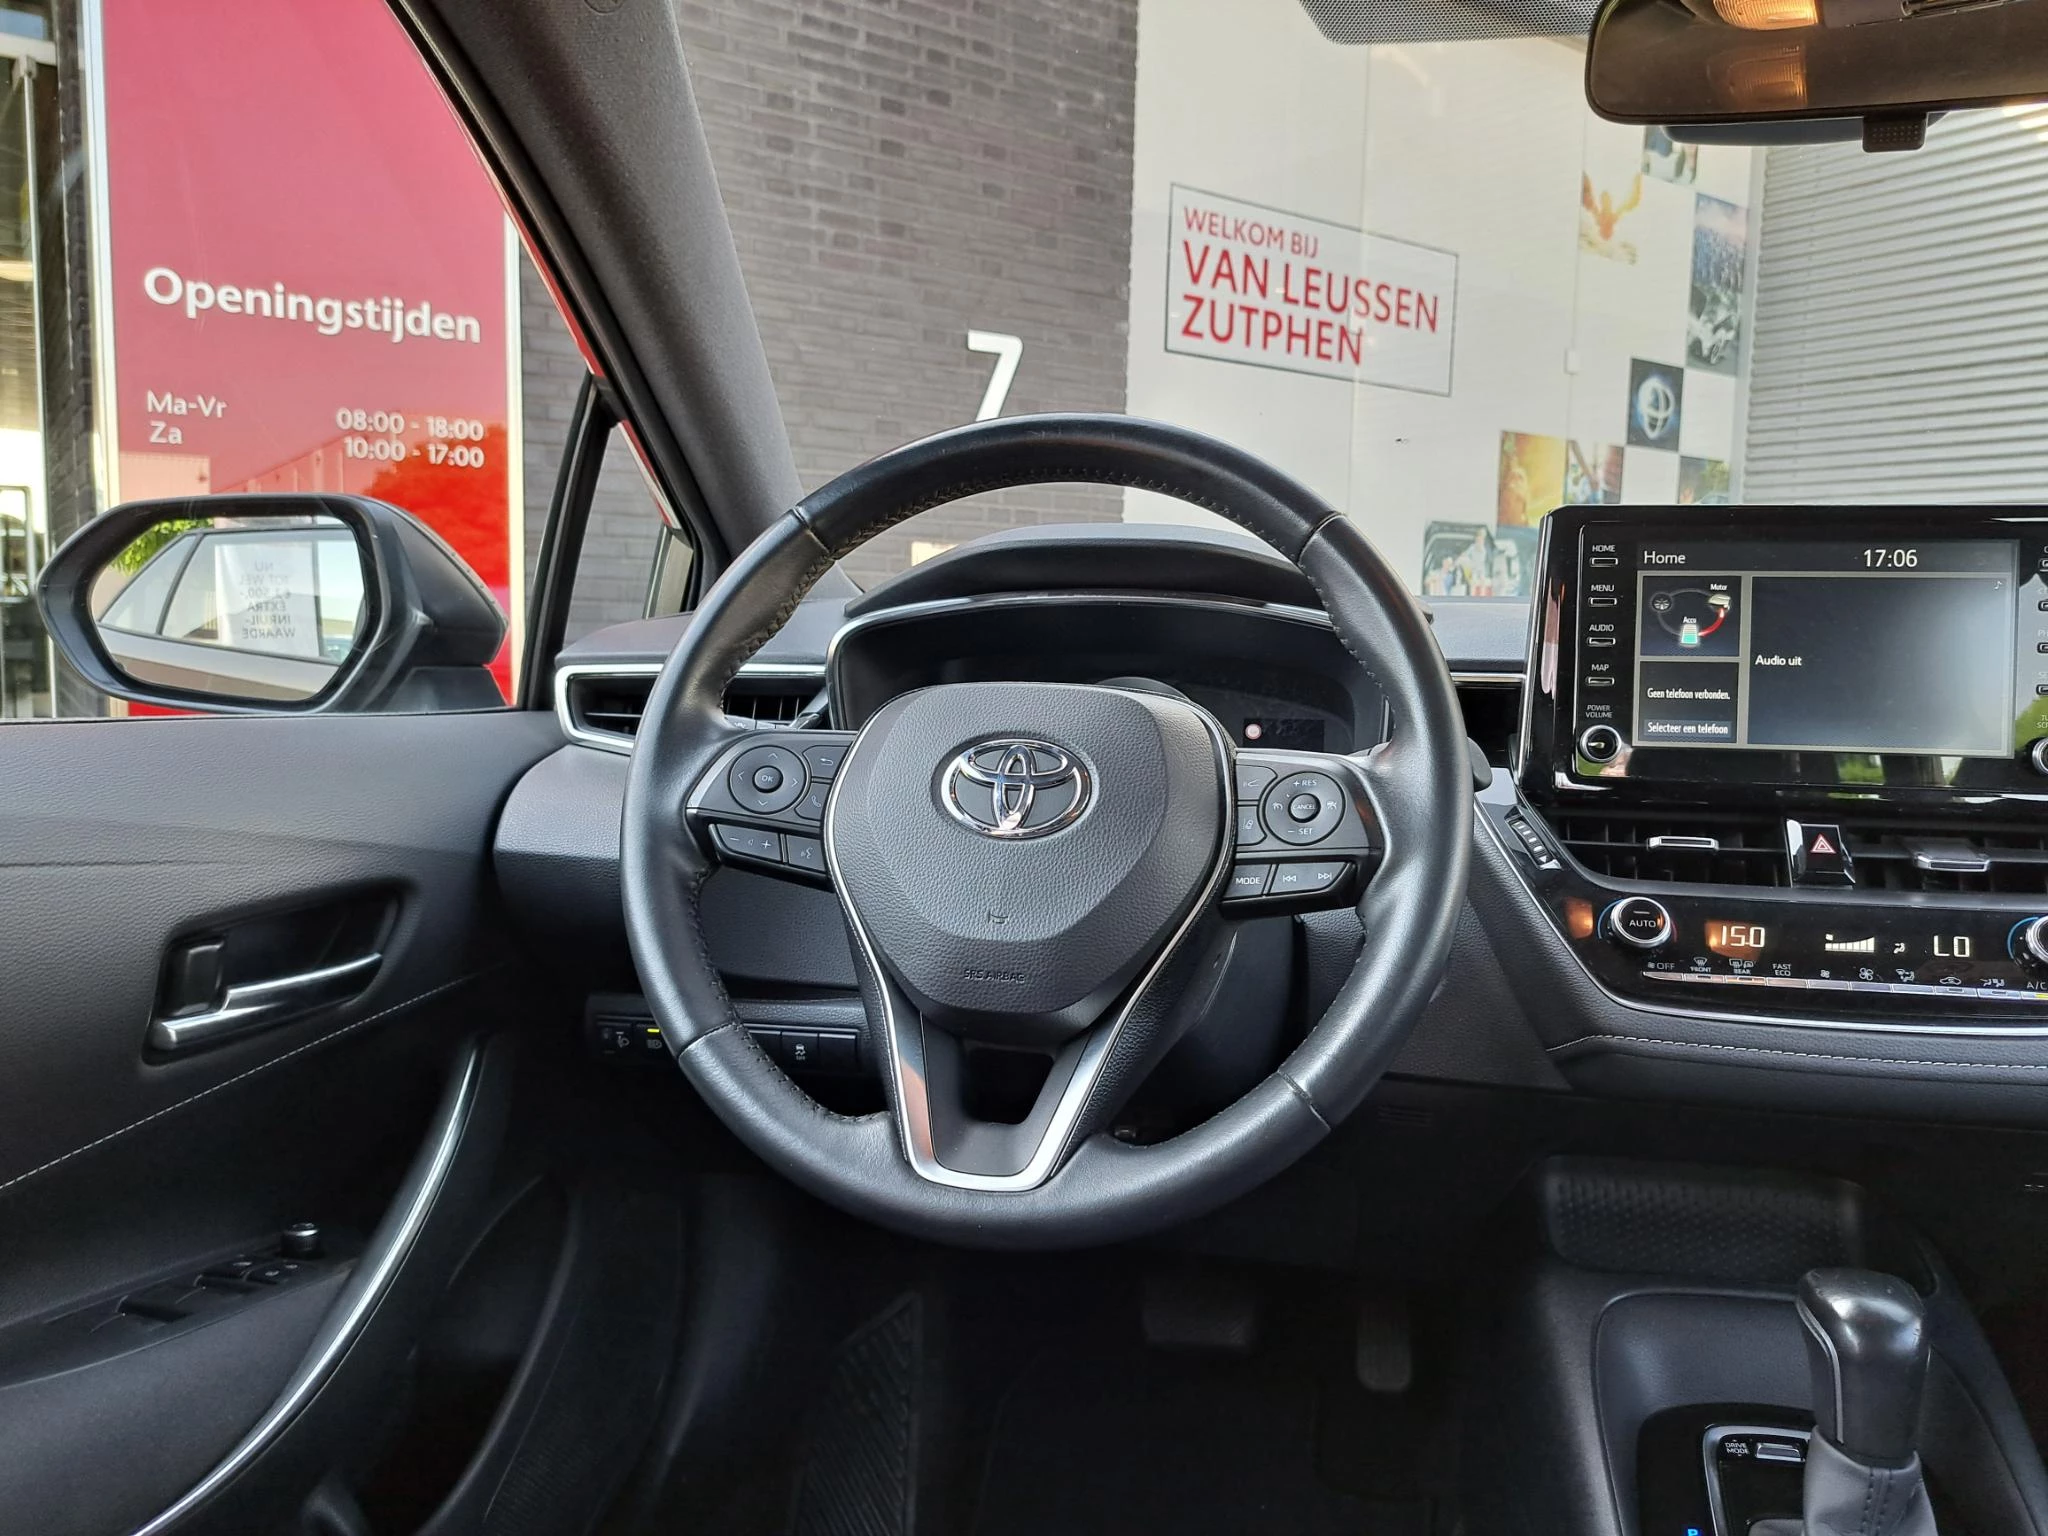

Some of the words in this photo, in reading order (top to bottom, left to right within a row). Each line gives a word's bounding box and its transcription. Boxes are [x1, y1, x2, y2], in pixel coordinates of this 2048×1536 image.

[1184, 206, 1284, 253] WELKOM
[1290, 232, 1319, 259] BIJ
[1183, 239, 1269, 300] VAN
[1283, 263, 1439, 333] LEUSSEN
[143, 267, 481, 344] Openingstijden
[1182, 294, 1363, 366] ZUTPHEN
[147, 390, 226, 418] Ma-Vr
[336, 407, 405, 434] 08:00
[426, 415, 484, 442] 18:00
[150, 422, 183, 446] Za
[343, 436, 406, 462] 10:00
[427, 443, 485, 469] 17:00
[1591, 544, 1616, 553] HOME
[1643, 550, 1686, 564] Home
[1863, 549, 1918, 568] 17:06
[1590, 584, 1615, 592] MENU
[1589, 624, 1615, 632] AUDIO
[1755, 654, 1786, 666] Audio
[1788, 655, 1802, 666] uit
[1647, 687, 1665, 699] Geen
[1665, 688, 1694, 700] telefoon
[1586, 704, 1611, 712] POWER
[1585, 711, 1613, 719] VOLUME
[1647, 721, 1682, 734] Selecteer
[1682, 724, 1697, 734] een
[1697, 723, 1729, 735] telefoon
[1298, 827, 1313, 836] SET
[1235, 877, 1262, 886] MODE
[1629, 919, 1656, 929] AUTO
[1656, 962, 1676, 971] OFF
[1772, 963, 1792, 971] FAST
[1774, 970, 1791, 978] ECO
